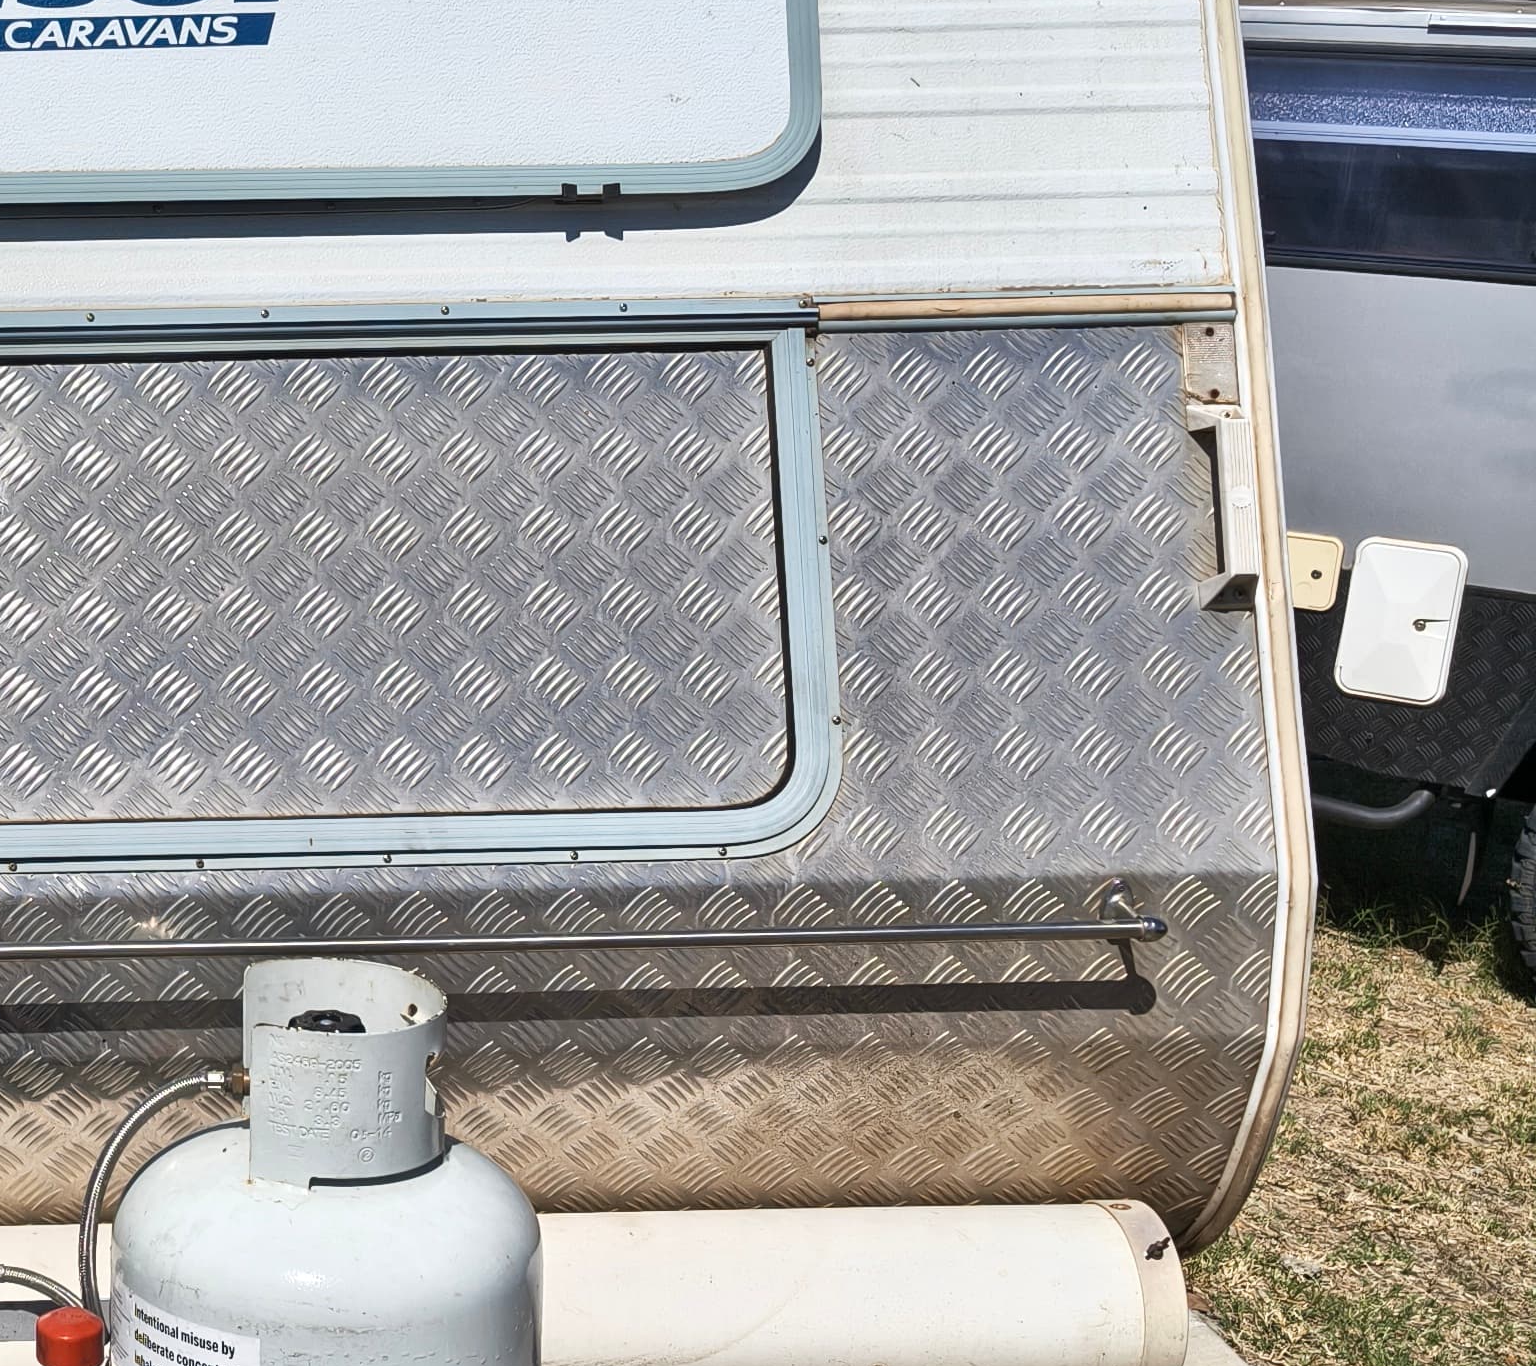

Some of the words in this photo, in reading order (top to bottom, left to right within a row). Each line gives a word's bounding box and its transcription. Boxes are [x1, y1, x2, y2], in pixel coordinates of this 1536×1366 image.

[4, 12, 238, 49] CARAVANS
[134, 1302, 179, 1339] Intentional
[181, 1331, 219, 1353] misuse
[221, 1340, 236, 1360] by
[134, 1328, 175, 1362] deliberate
